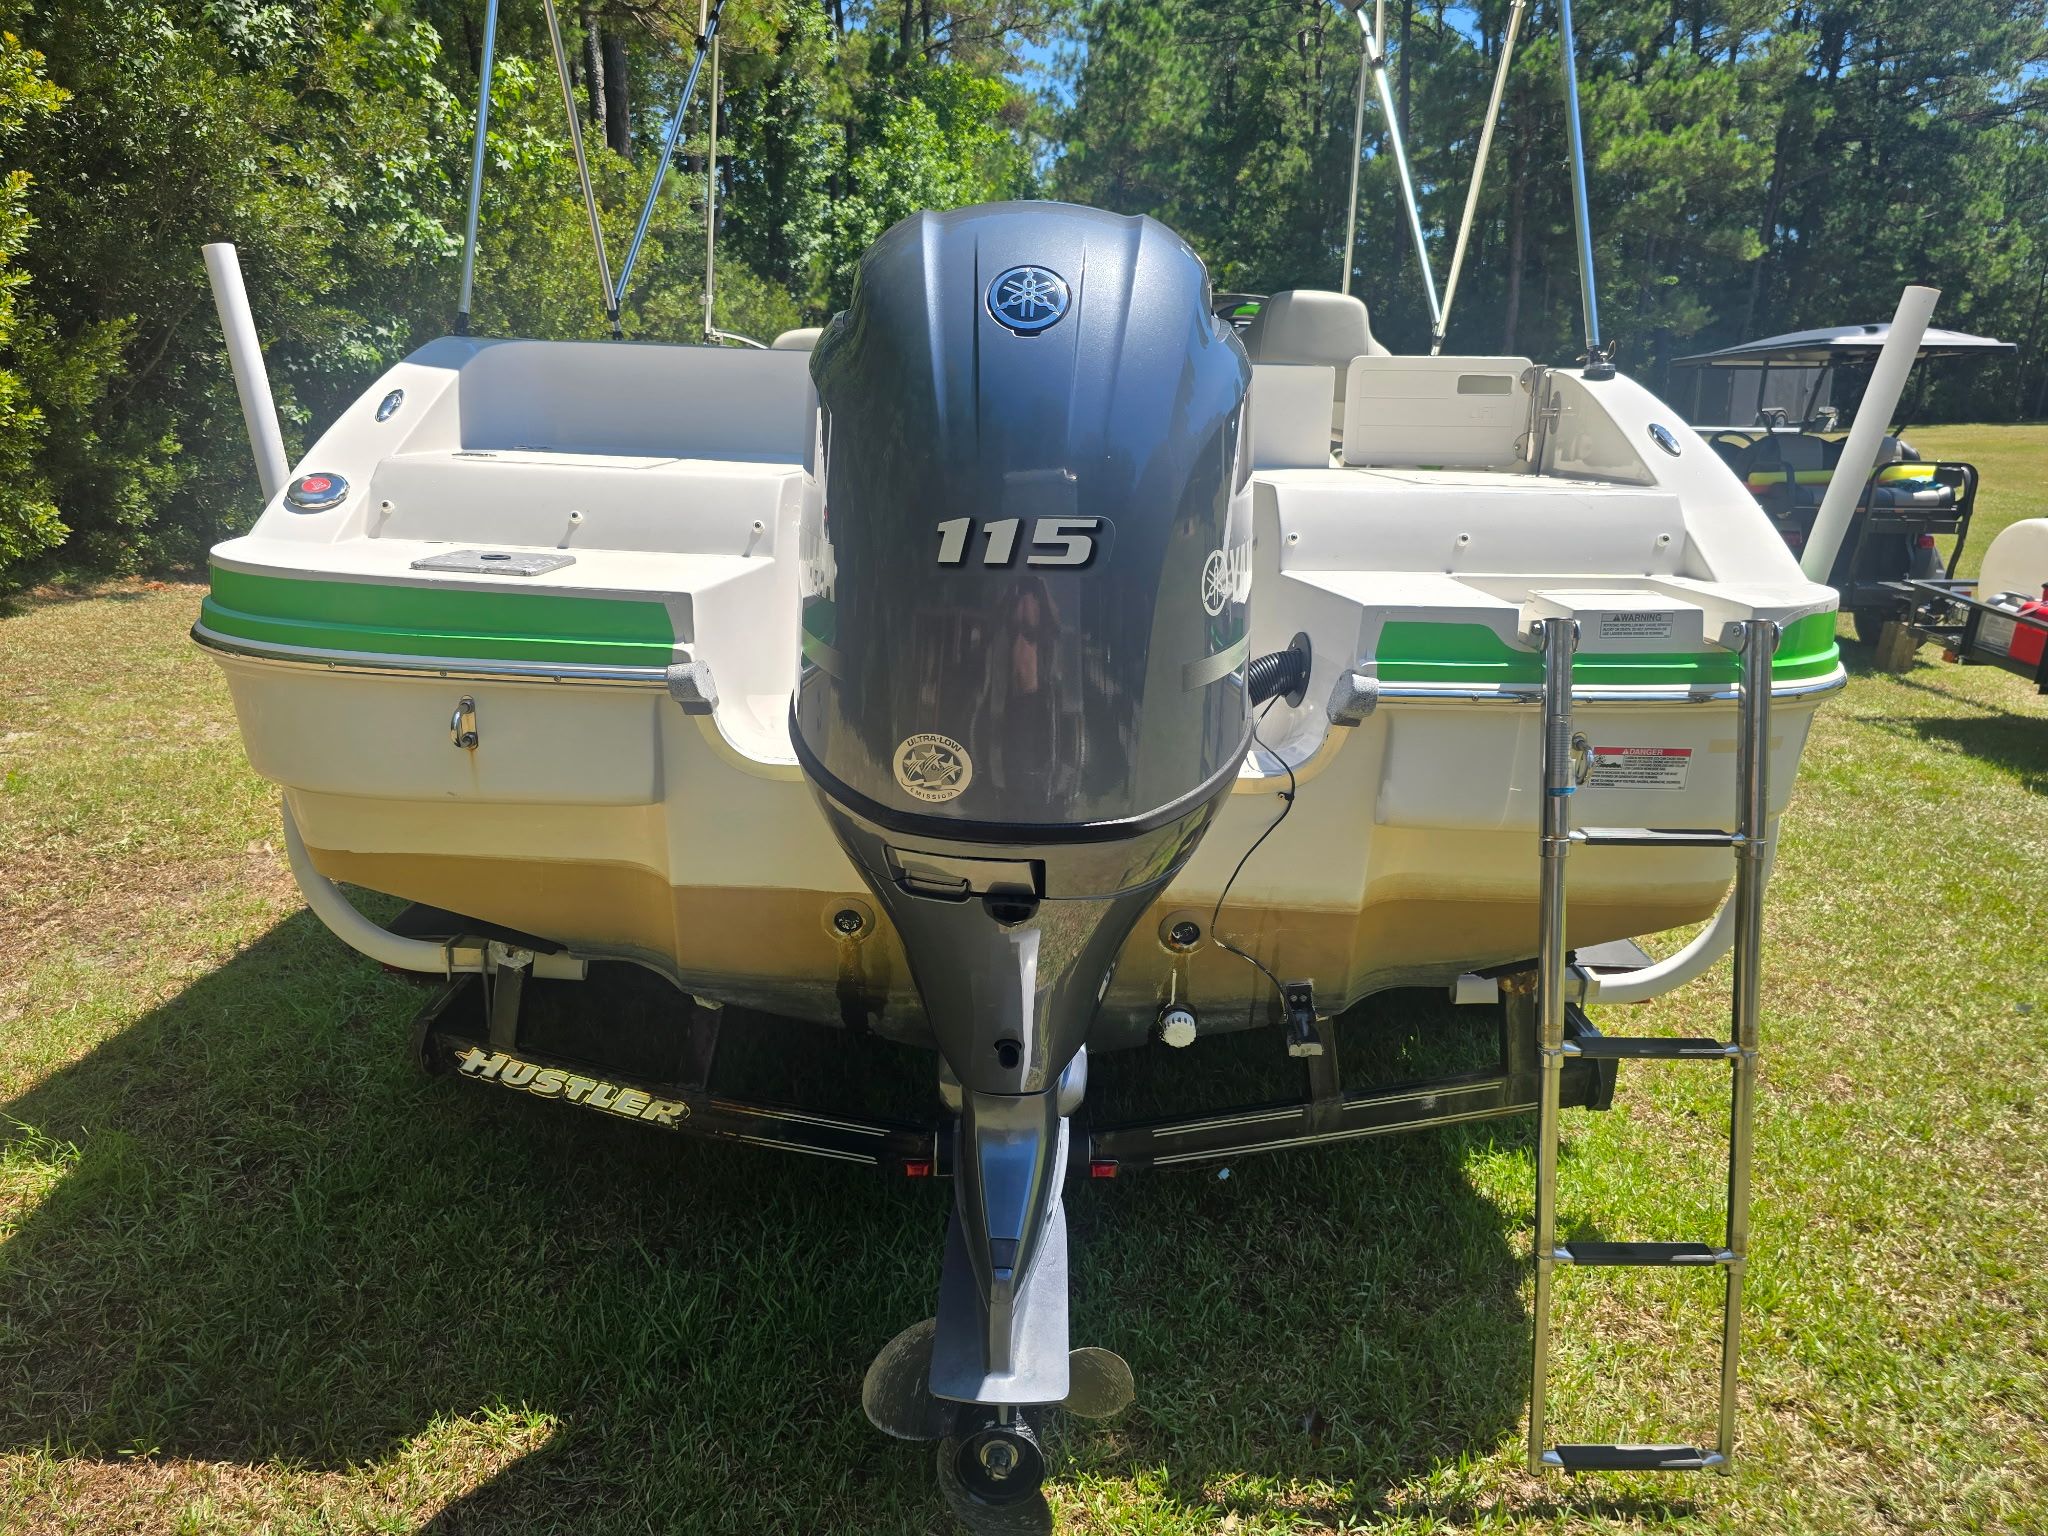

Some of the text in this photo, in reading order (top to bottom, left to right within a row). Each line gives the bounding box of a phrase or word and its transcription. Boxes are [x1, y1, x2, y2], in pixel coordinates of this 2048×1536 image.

[937, 517, 1098, 565] 115
[1621, 613, 1662, 622] WARNING
[1629, 748, 1664, 756] DANGER
[909, 787, 953, 800] EMISSION
[457, 1048, 690, 1128] HUSTLER
